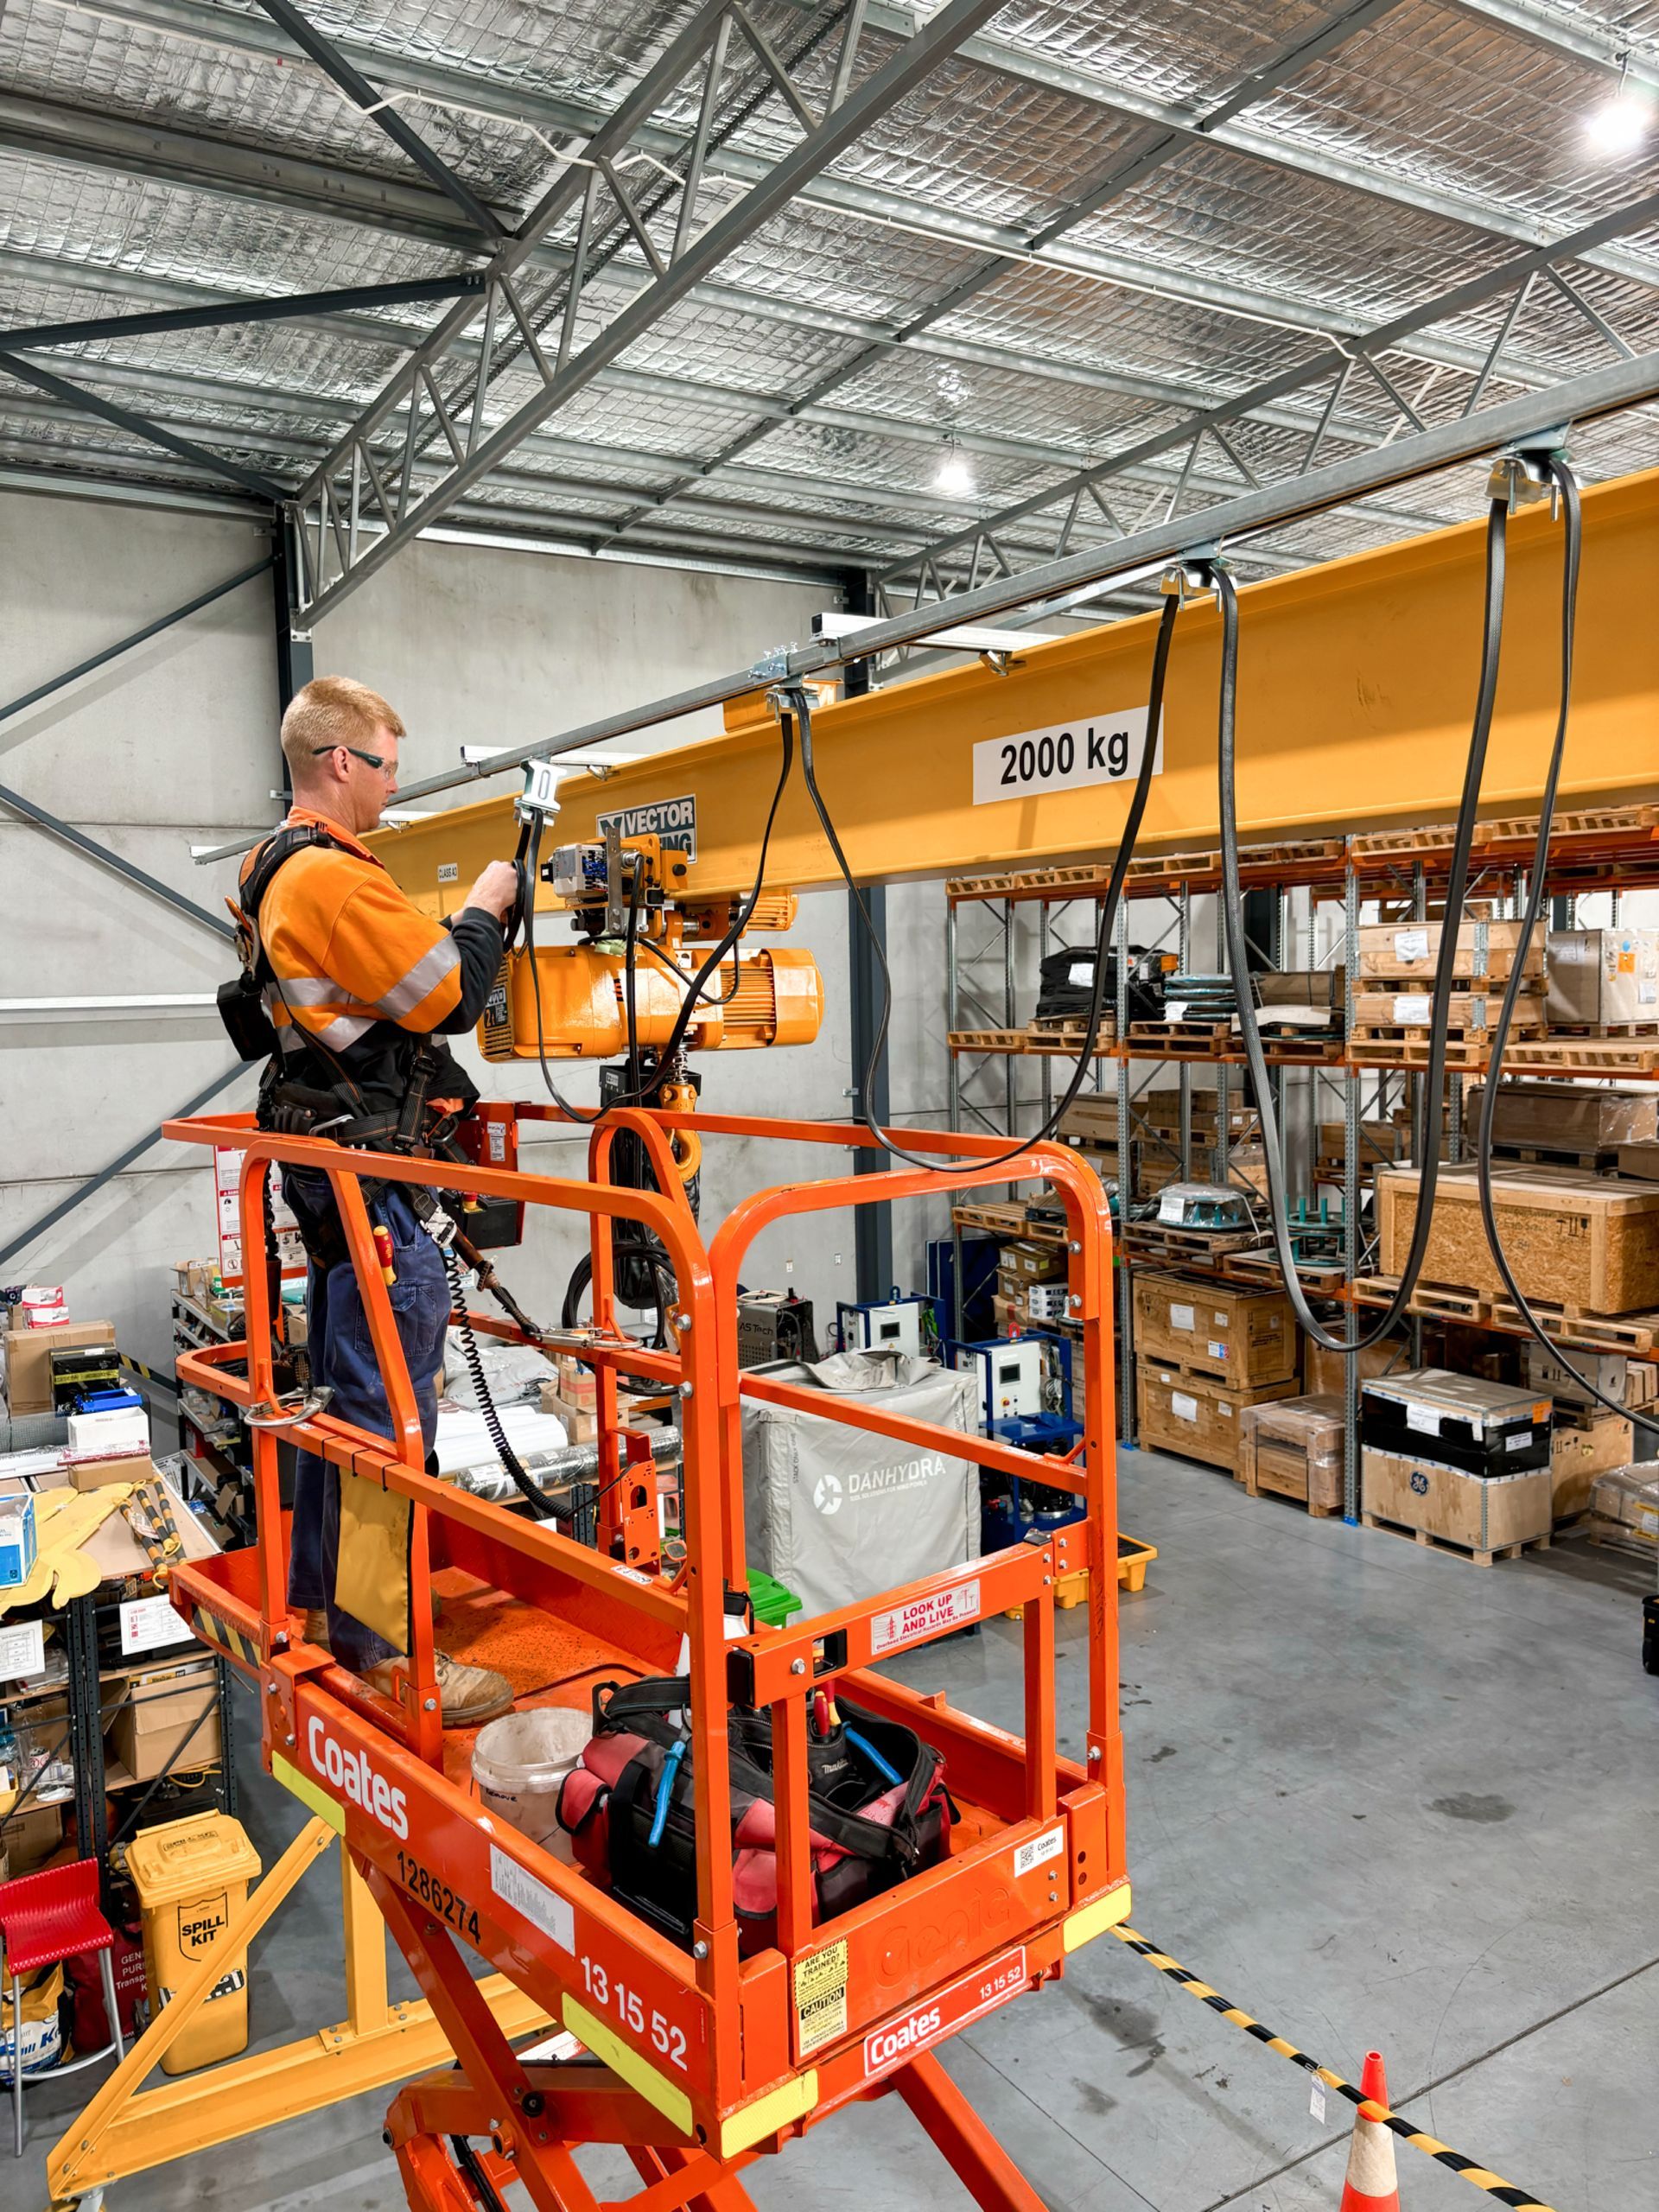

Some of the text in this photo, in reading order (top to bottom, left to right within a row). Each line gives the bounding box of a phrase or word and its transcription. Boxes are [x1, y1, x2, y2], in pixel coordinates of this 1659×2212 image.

[1001, 727, 1128, 785] 2000 kg
[625, 801, 694, 836] VECTOR
[849, 1456, 947, 1494] DANHYDRA
[902, 1605, 954, 1634] AND LIVE
[903, 1593, 953, 1621] LOOK UP
[308, 1715, 409, 1840] Coates
[1037, 1836, 1057, 1851] Coates
[397, 1851, 481, 1945] 1286274
[181, 1915, 225, 1936] SPILL
[192, 1929, 217, 1947] KIT
[804, 1946, 838, 1968] ARE YOU
[804, 1953, 840, 1978] TRAINED?
[979, 1966, 1021, 1999] 13 15 52
[581, 1955, 609, 2005] 13
[614, 1982, 645, 2033] 15
[652, 2009, 688, 2072] 52
[803, 1987, 843, 2018] CAUTION
[870, 2007, 941, 2066] Coates
